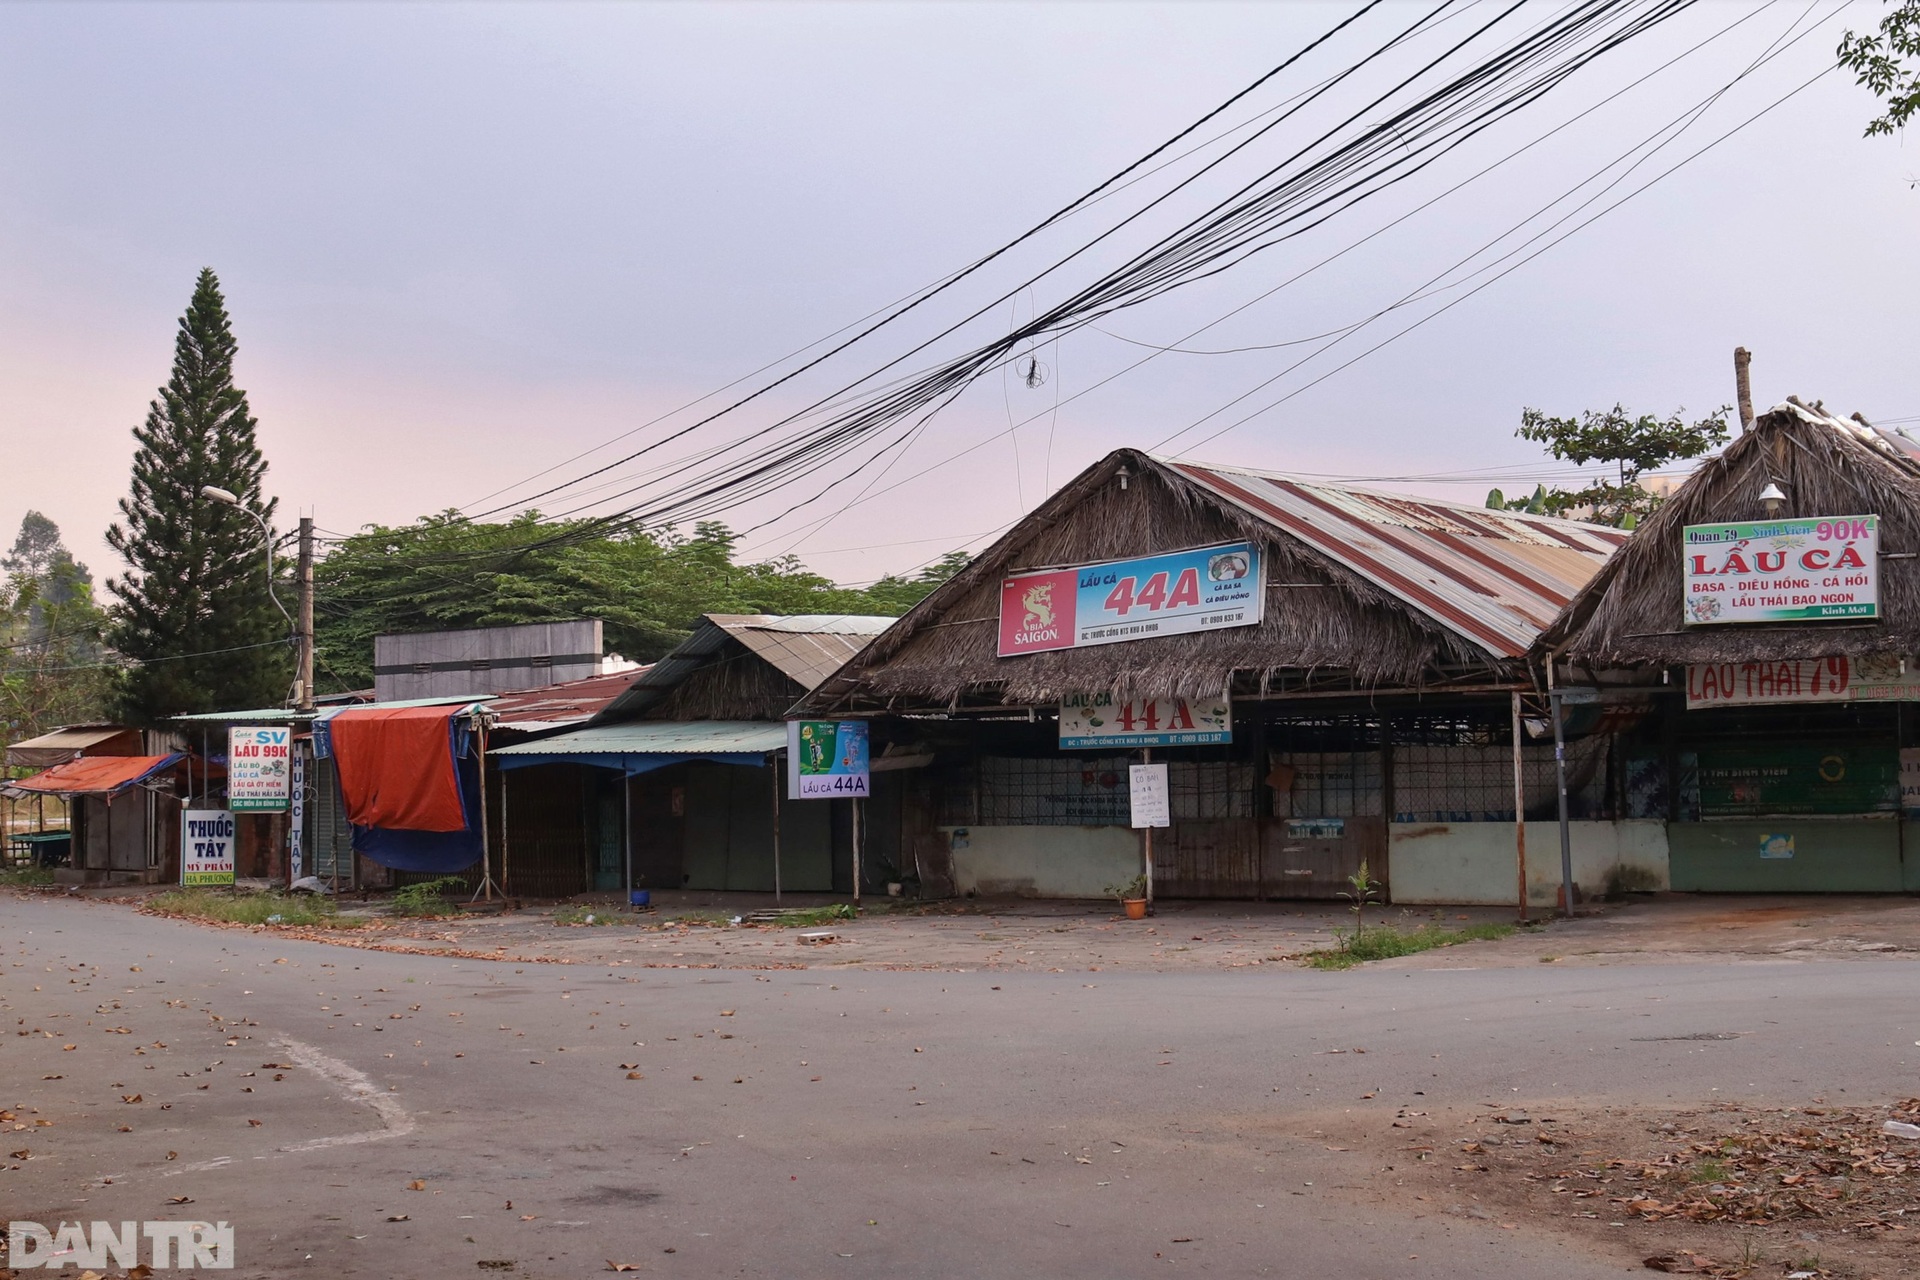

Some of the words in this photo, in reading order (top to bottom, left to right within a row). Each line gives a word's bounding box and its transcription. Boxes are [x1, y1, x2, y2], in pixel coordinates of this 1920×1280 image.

[1690, 529, 1720, 544] Quán
[1725, 529, 1737, 541] 79
[1753, 526, 1780, 538] Sinh
[1784, 524, 1810, 536] Viên
[1816, 519, 1869, 541] 90K
[1690, 540, 1787, 576] LẨU
[1800, 542, 1866, 572] CÁ
[1080, 573, 1100, 588] LẨU
[1103, 572, 1116, 584] CÁ
[1693, 582, 1725, 592] BASA
[1774, 576, 1809, 589] HỒNG
[1823, 575, 1839, 587] CÁ
[1845, 572, 1868, 586] HỒI
[1104, 568, 1200, 617] 44A
[1732, 593, 1755, 607] LẨU
[1760, 593, 1787, 606] THÁI
[1792, 595, 1816, 604] BAO
[1848, 605, 1866, 613] Mời
[1210, 615, 1222, 624] 0909
[1015, 629, 1058, 644] SAIGON
[1811, 656, 1849, 696] 79
[256, 731, 286, 744] SV
[235, 740, 259, 757] LẨU
[264, 746, 287, 757] 99K
[821, 783, 831, 792] CÁ
[834, 777, 865, 792] 44A
[188, 814, 232, 837] THUỐC
[195, 839, 226, 857] TÂY
[292, 830, 300, 873] TÂY
